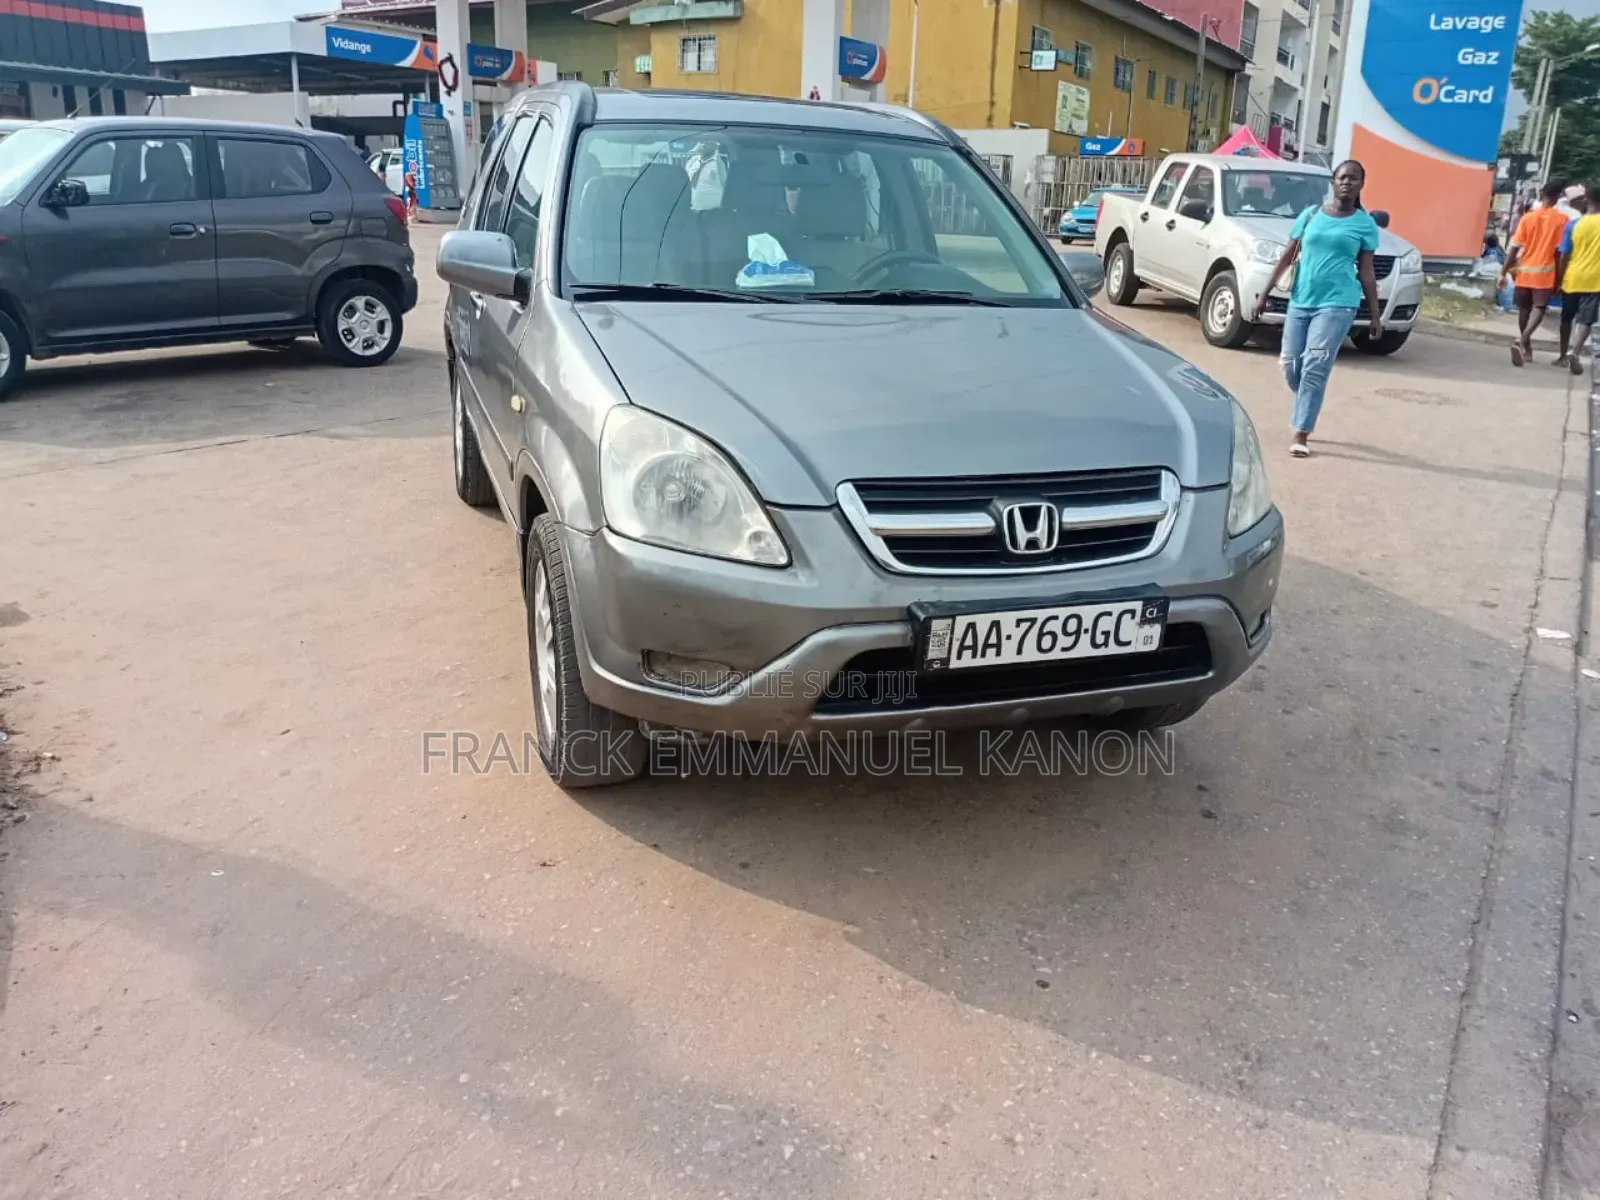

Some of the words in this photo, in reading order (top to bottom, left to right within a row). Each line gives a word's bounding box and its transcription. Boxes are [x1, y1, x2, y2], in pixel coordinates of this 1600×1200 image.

[1429, 13, 1506, 33] Lavage
[331, 36, 372, 54] Vidange
[1457, 48, 1500, 64] Gaz
[1085, 141, 1101, 151] Gaz
